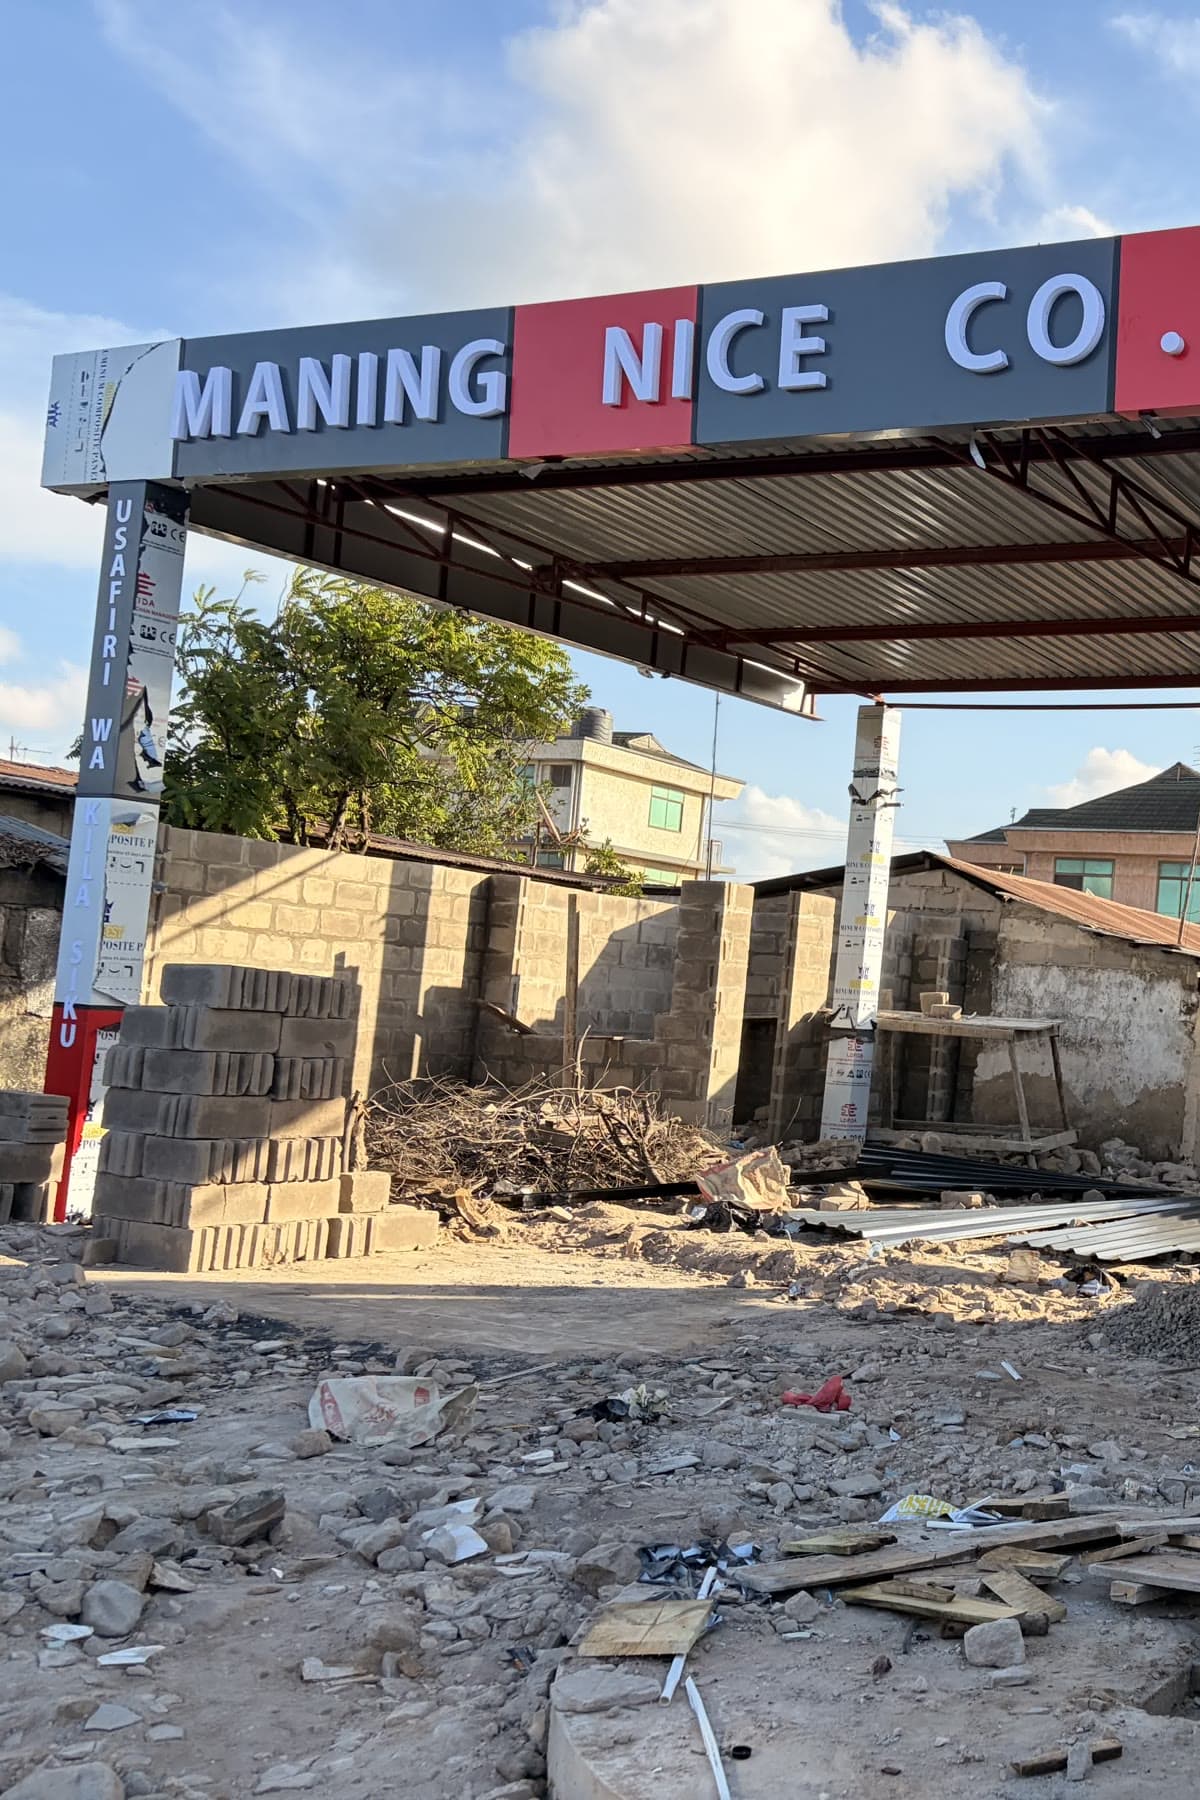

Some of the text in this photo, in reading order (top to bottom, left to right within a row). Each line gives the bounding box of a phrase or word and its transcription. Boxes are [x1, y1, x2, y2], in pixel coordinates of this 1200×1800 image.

[169, 338, 507, 440] MANING
[601, 303, 830, 407] NICE
[59, 499, 132, 1048] USAFIRI WA KILA SIKU
